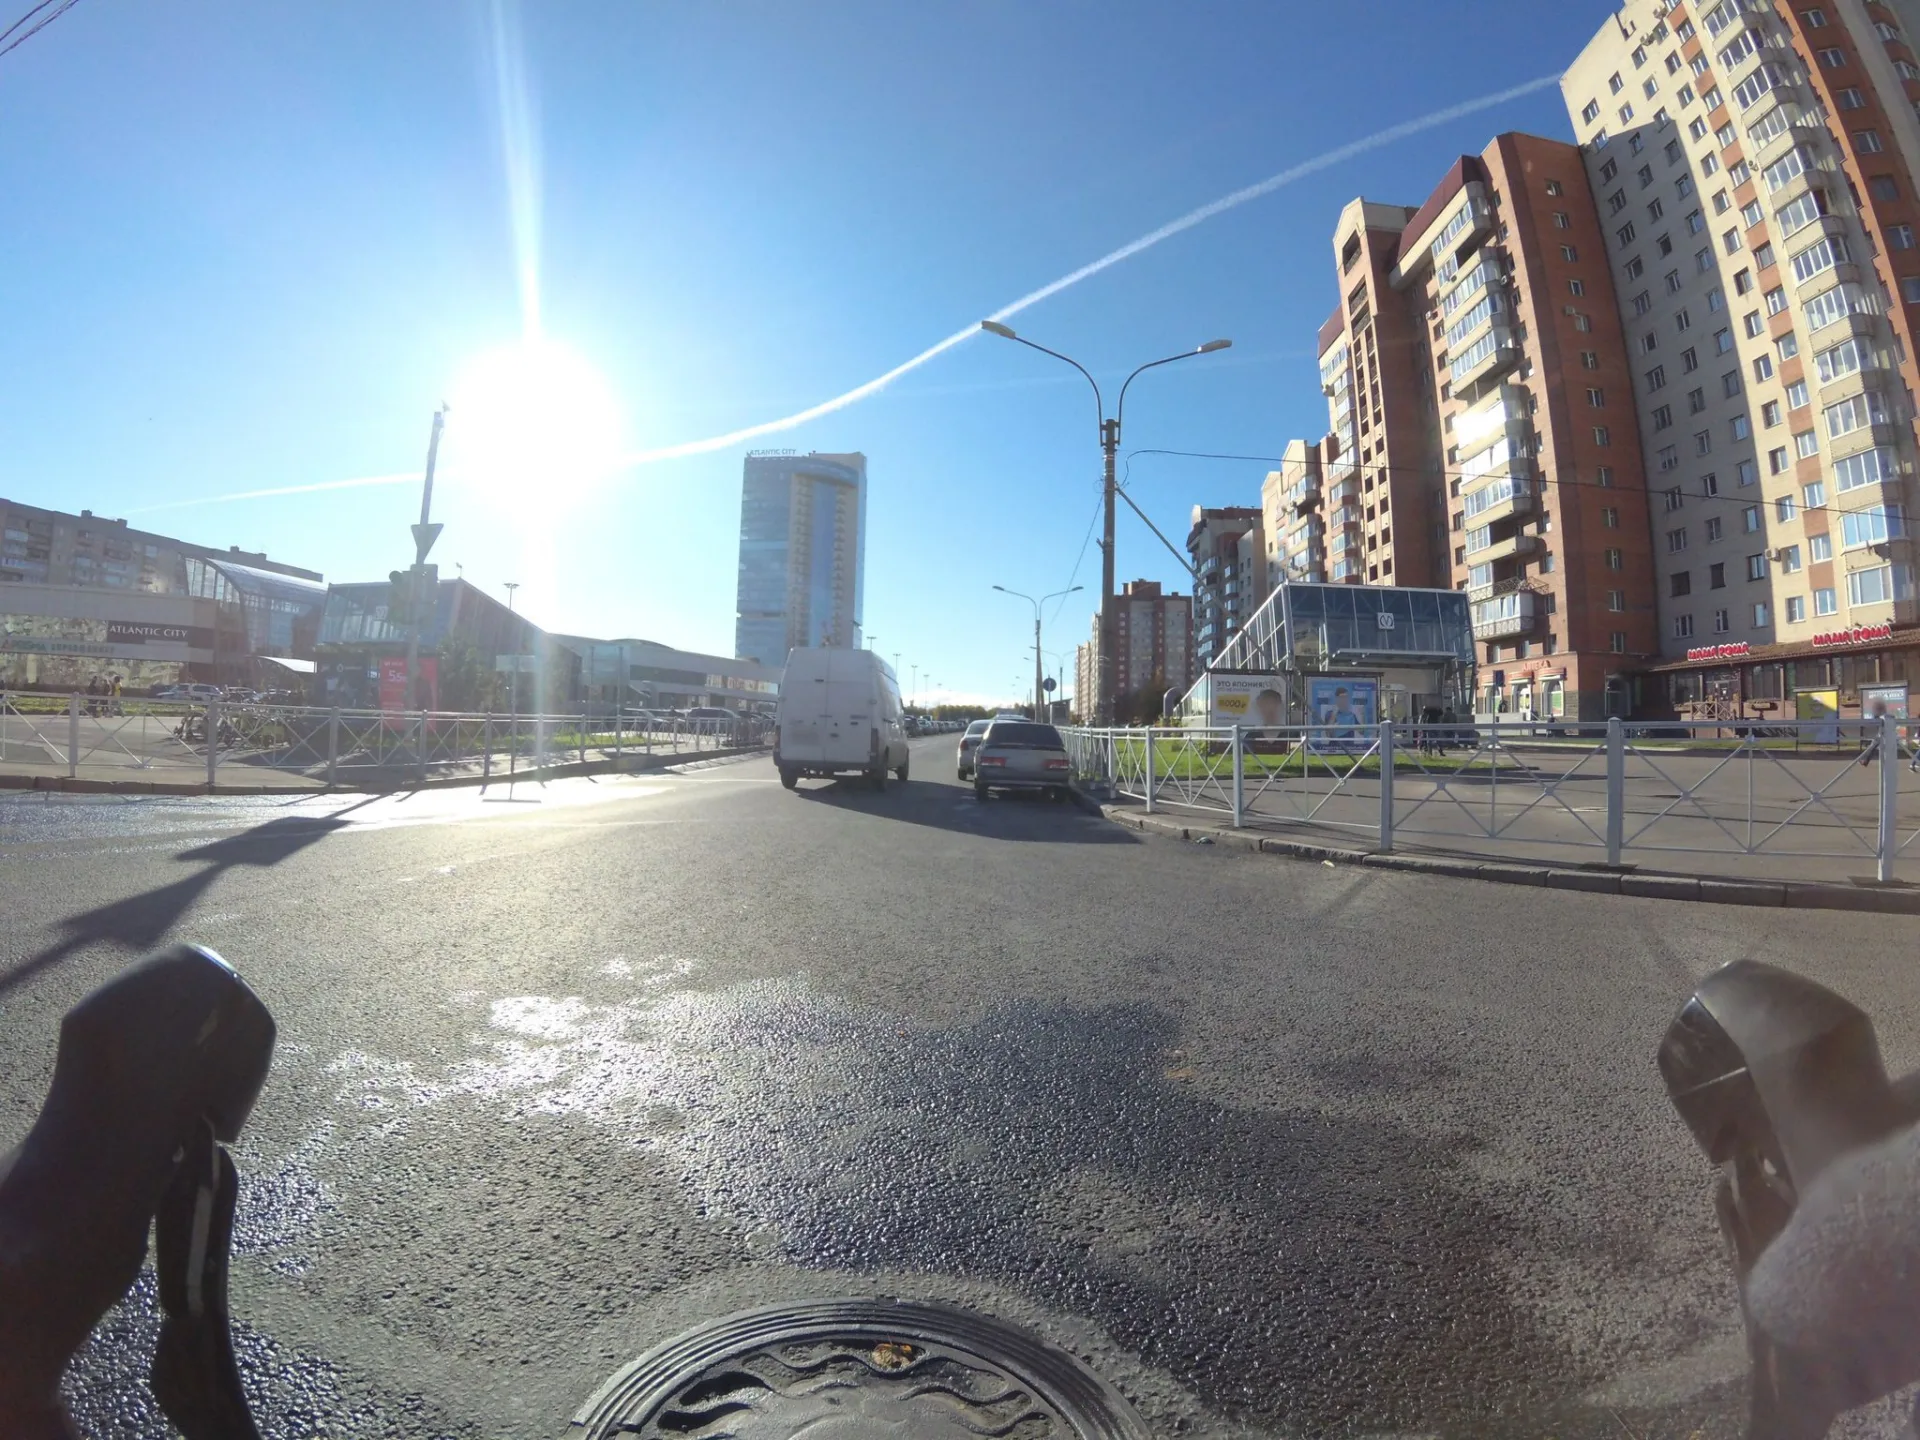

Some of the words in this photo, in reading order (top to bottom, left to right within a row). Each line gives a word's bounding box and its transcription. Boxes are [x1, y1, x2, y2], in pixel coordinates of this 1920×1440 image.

[750, 448, 780, 456] ATLANTIC
[109, 625, 160, 636] ATLANTIC
[164, 628, 188, 637] CITY
[1852, 623, 1892, 643] ROMA
